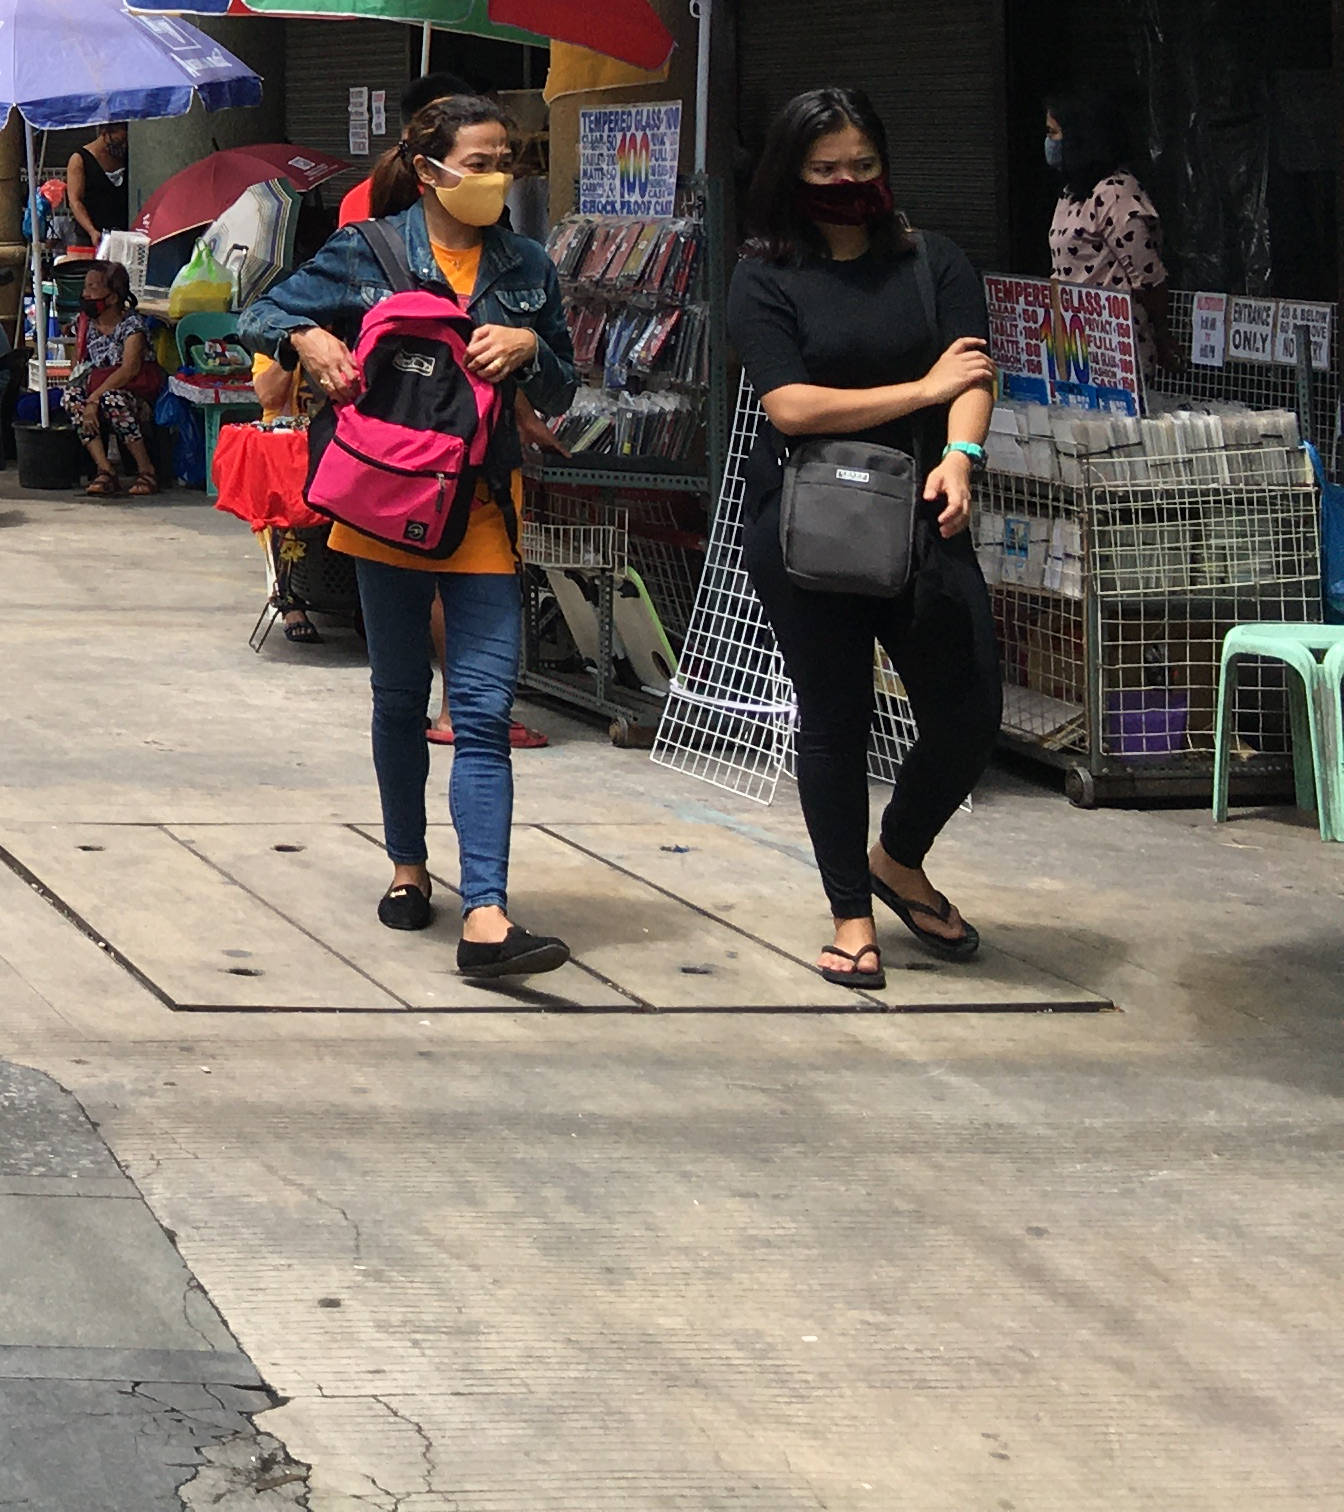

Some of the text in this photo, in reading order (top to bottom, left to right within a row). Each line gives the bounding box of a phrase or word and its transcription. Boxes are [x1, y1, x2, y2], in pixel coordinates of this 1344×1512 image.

[617, 131, 650, 199] 100
[986, 278, 1129, 320] TEMPERE GLASS 100
[1023, 309, 1038, 323] 50
[1234, 303, 1271, 327] ENTRANCE
[1300, 309, 1328, 324] BELOW
[1232, 329, 1268, 353] ONLY
[1283, 337, 1294, 358] NO
